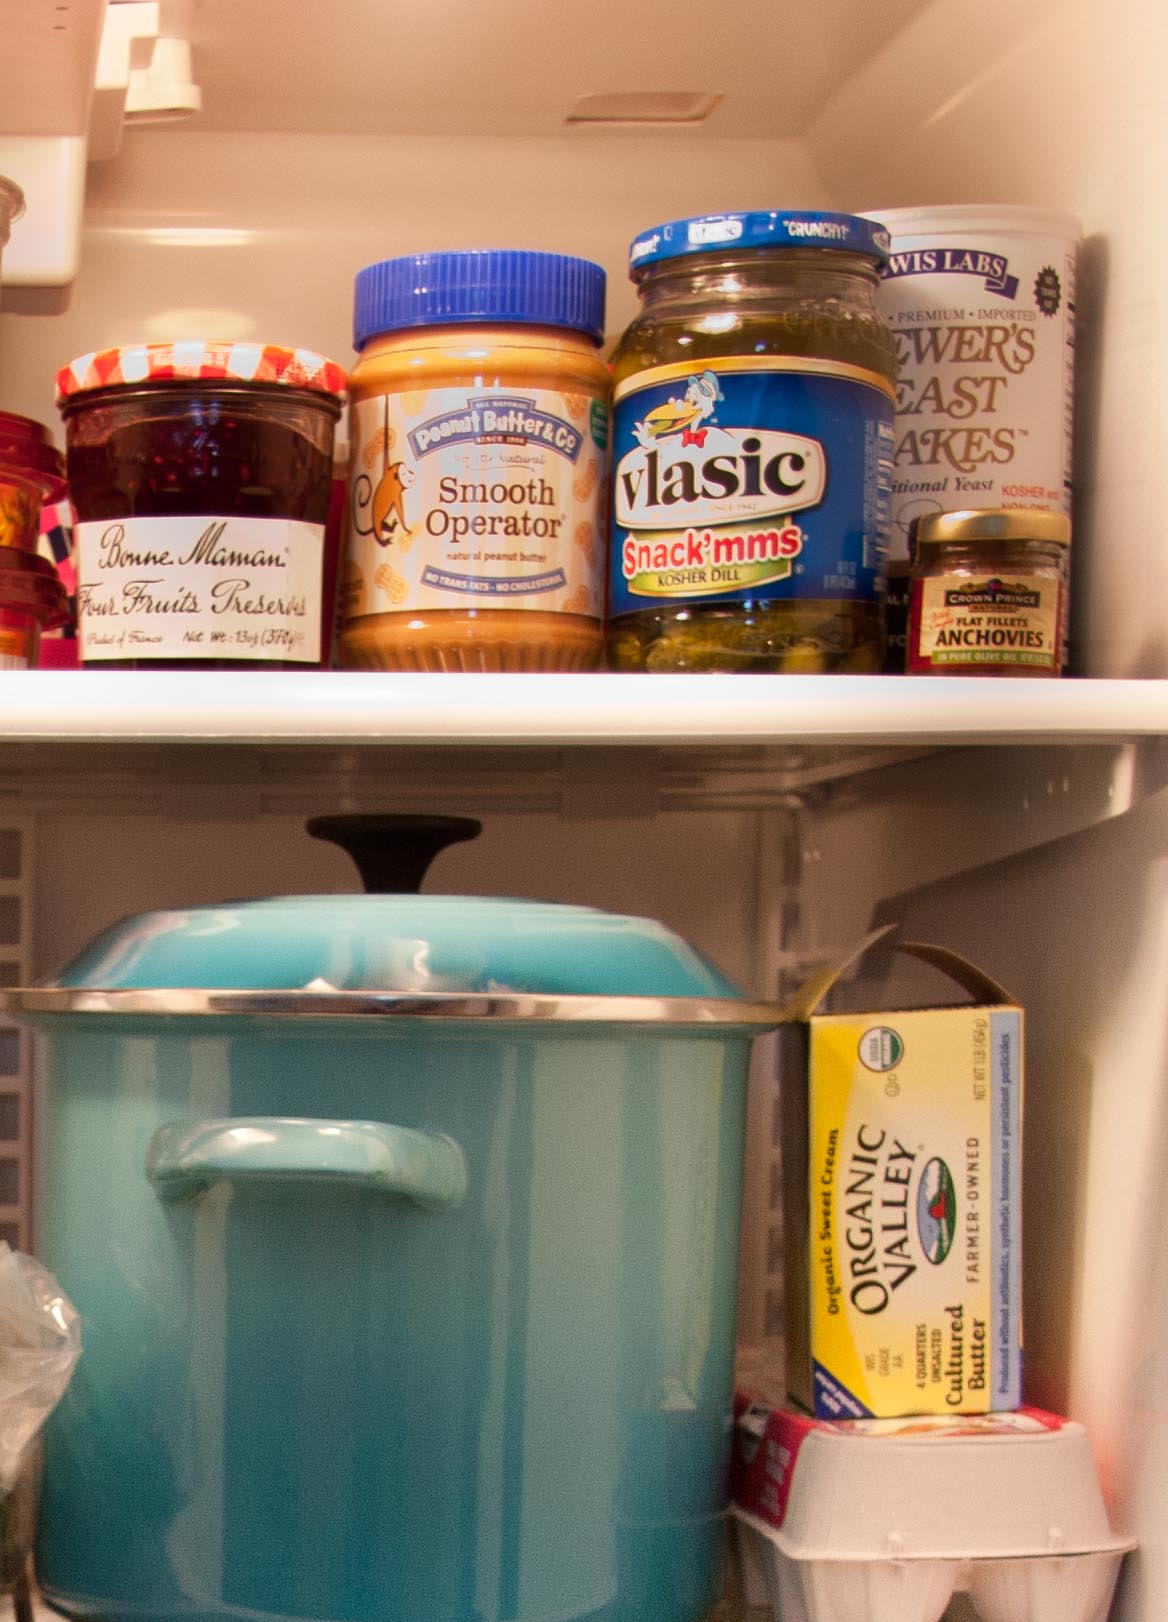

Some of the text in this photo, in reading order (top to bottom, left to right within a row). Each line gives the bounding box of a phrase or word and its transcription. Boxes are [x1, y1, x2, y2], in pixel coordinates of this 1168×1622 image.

[942, 251, 1006, 278] LABS
[977, 309, 1037, 321] IMPORTED
[414, 409, 480, 451] Peanut
[483, 409, 542, 437] Butter
[543, 422, 554, 442] &
[438, 475, 556, 507] Smooth
[953, 475, 994, 492] Yeast
[98, 520, 287, 569] Bonne Maman
[425, 508, 562, 544] Operator
[446, 551, 548, 564] natural peanut butter
[623, 528, 801, 577] Snack'mms
[656, 567, 742, 588] KOSHER DILL
[78, 581, 120, 617] Four
[121, 578, 202, 615] Fruits
[948, 593, 1036, 605] CROWN PRINCE
[936, 628, 1045, 648] ANCHOVIES
[956, 617, 1029, 628] FLAT FILLETS
[869, 1037, 881, 1062] USDA
[818, 1128, 842, 1316] Organic Sweet Cream
[844, 1123, 892, 1317] ORGANIC
[880, 1137, 918, 1293] VALLEY
[965, 1136, 980, 1285] FARMER-OWNED
[931, 1328, 943, 1384] UNSALTED
[944, 1304, 965, 1406] Cultured
[968, 1318, 987, 1391] Butter
